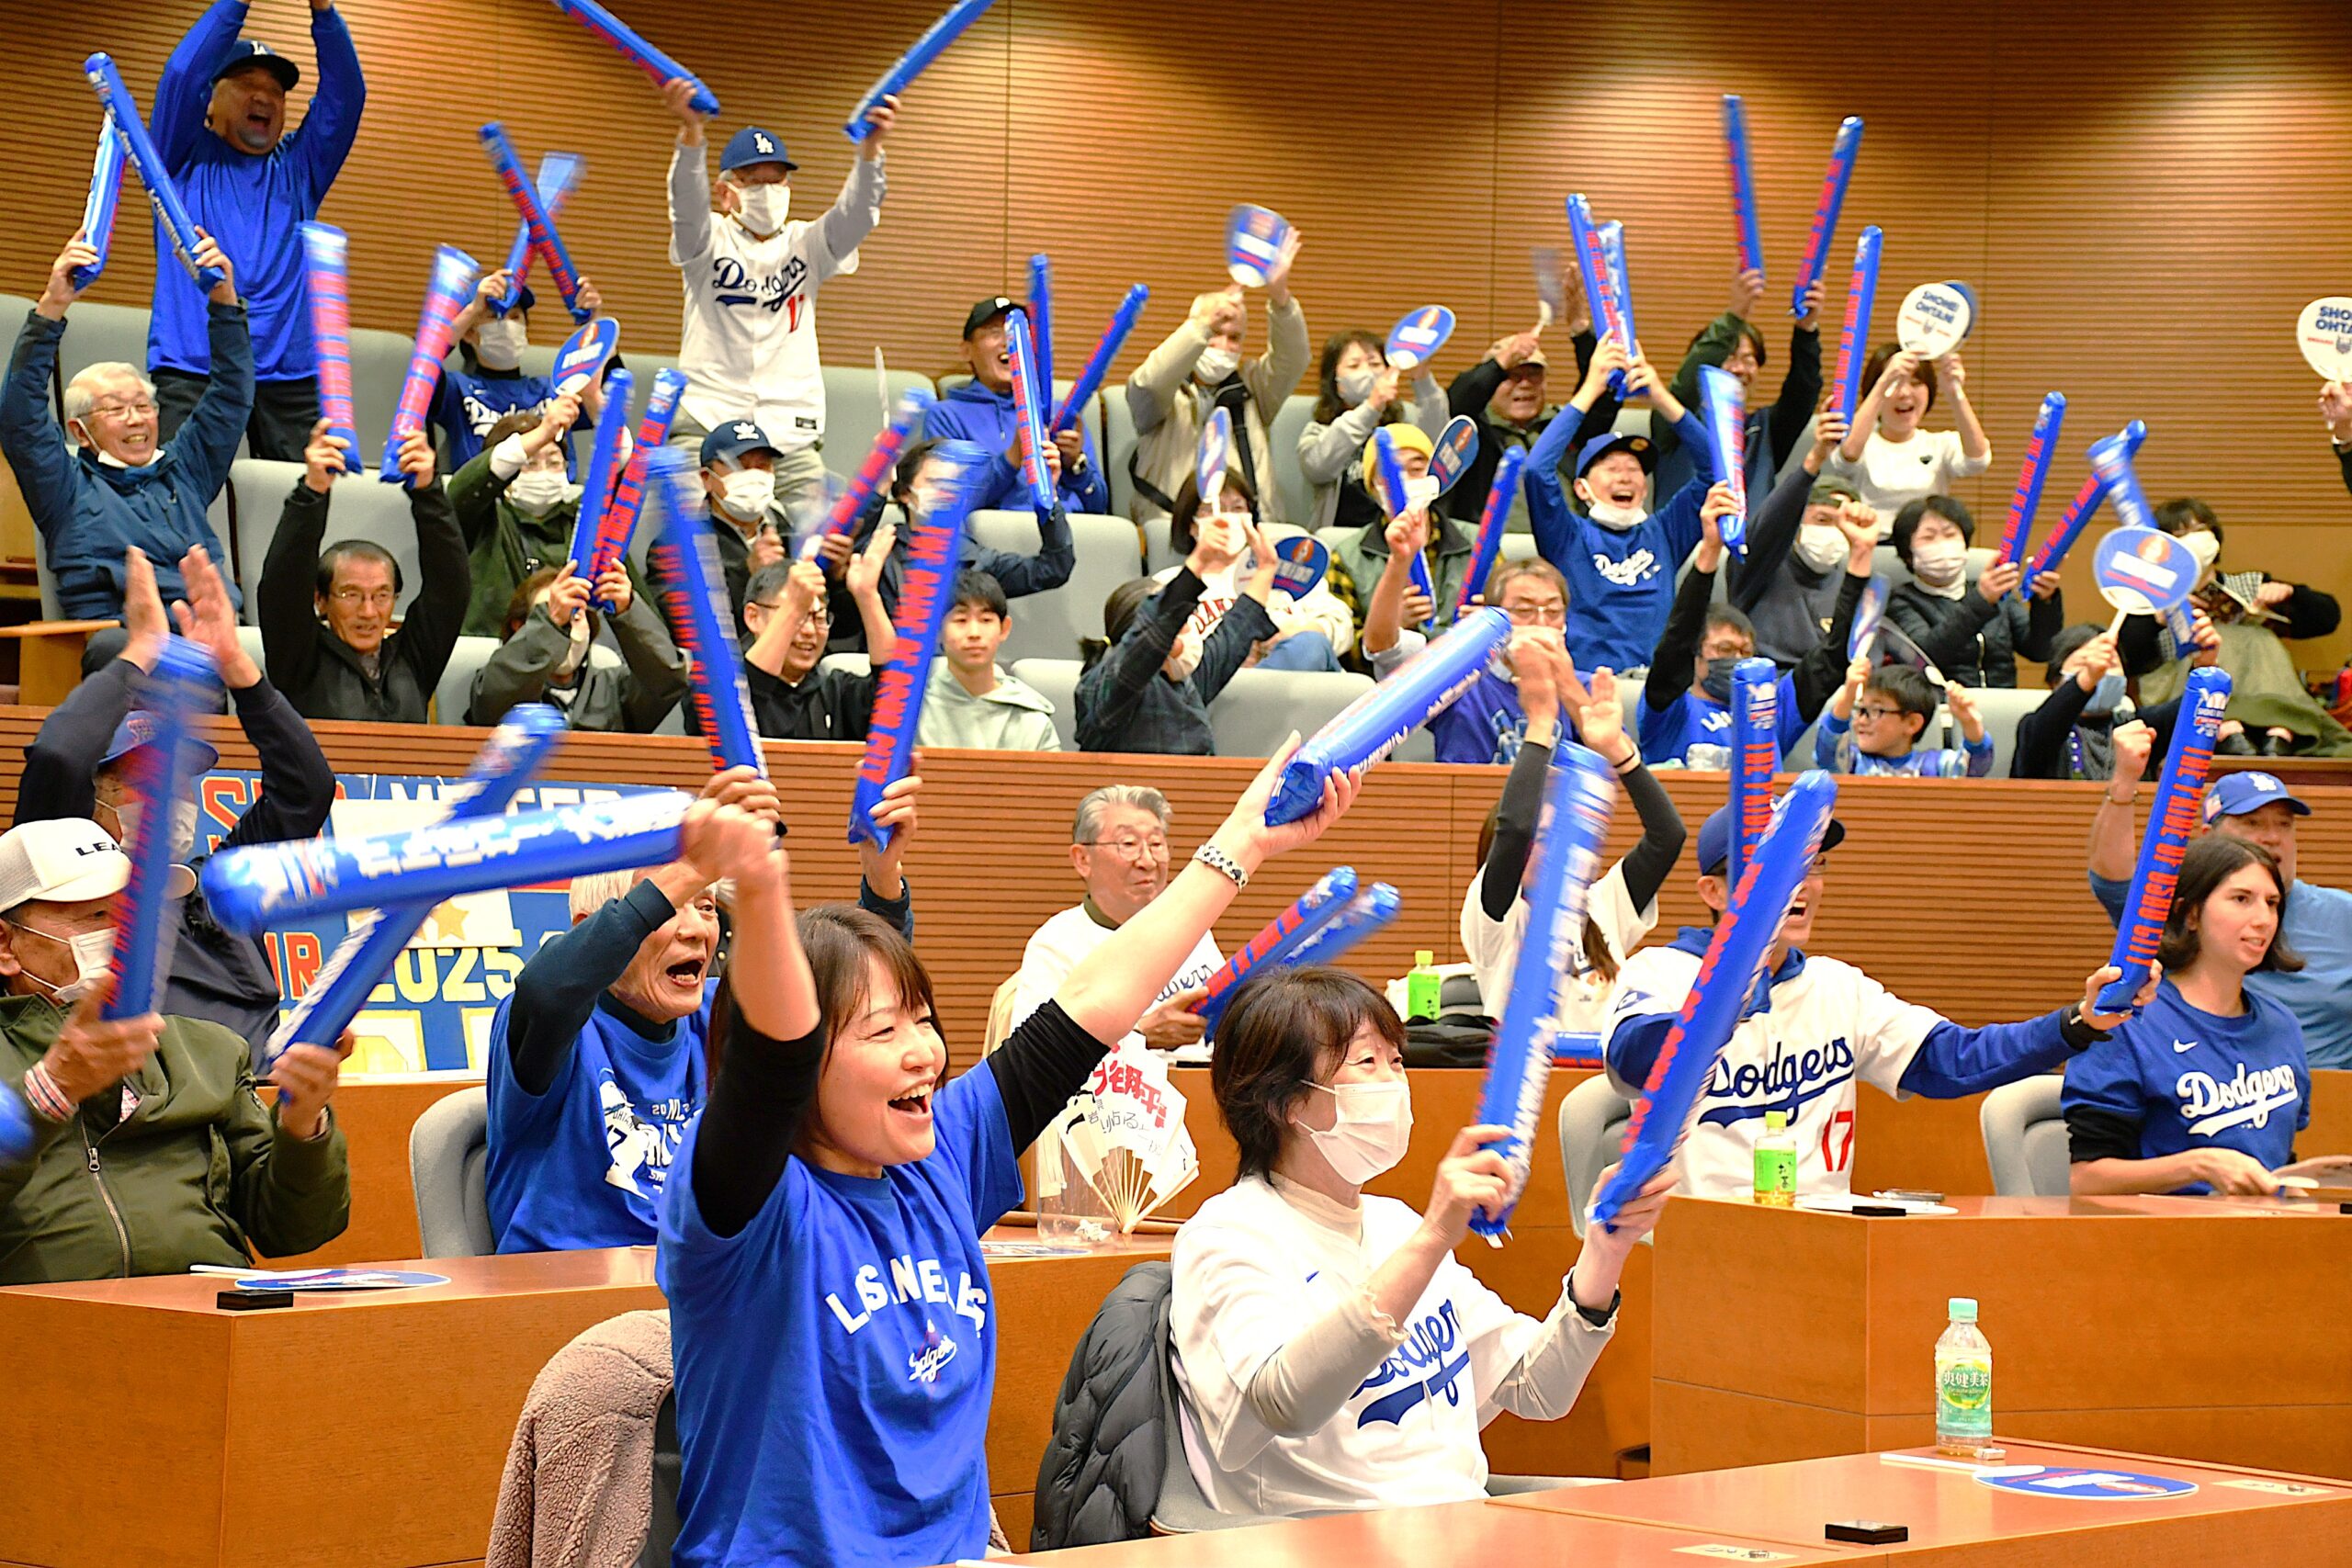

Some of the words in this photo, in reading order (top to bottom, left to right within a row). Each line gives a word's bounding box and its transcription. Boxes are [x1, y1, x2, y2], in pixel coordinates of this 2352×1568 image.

[752, 132, 775, 154] LA
[2320, 305, 2352, 321] SHO
[2176, 744, 2213, 783] THE
[2159, 782, 2201, 842] PRIDE
[75, 841, 122, 856] LEA
[2152, 840, 2186, 869] OF
[2136, 869, 2177, 923] OSHU
[2124, 922, 2163, 968] CITY
[2177, 1063, 2298, 1129] Dodgers
[1822, 1111, 1853, 1171] 17
[1943, 1372, 1989, 1388] 爽健美茶
